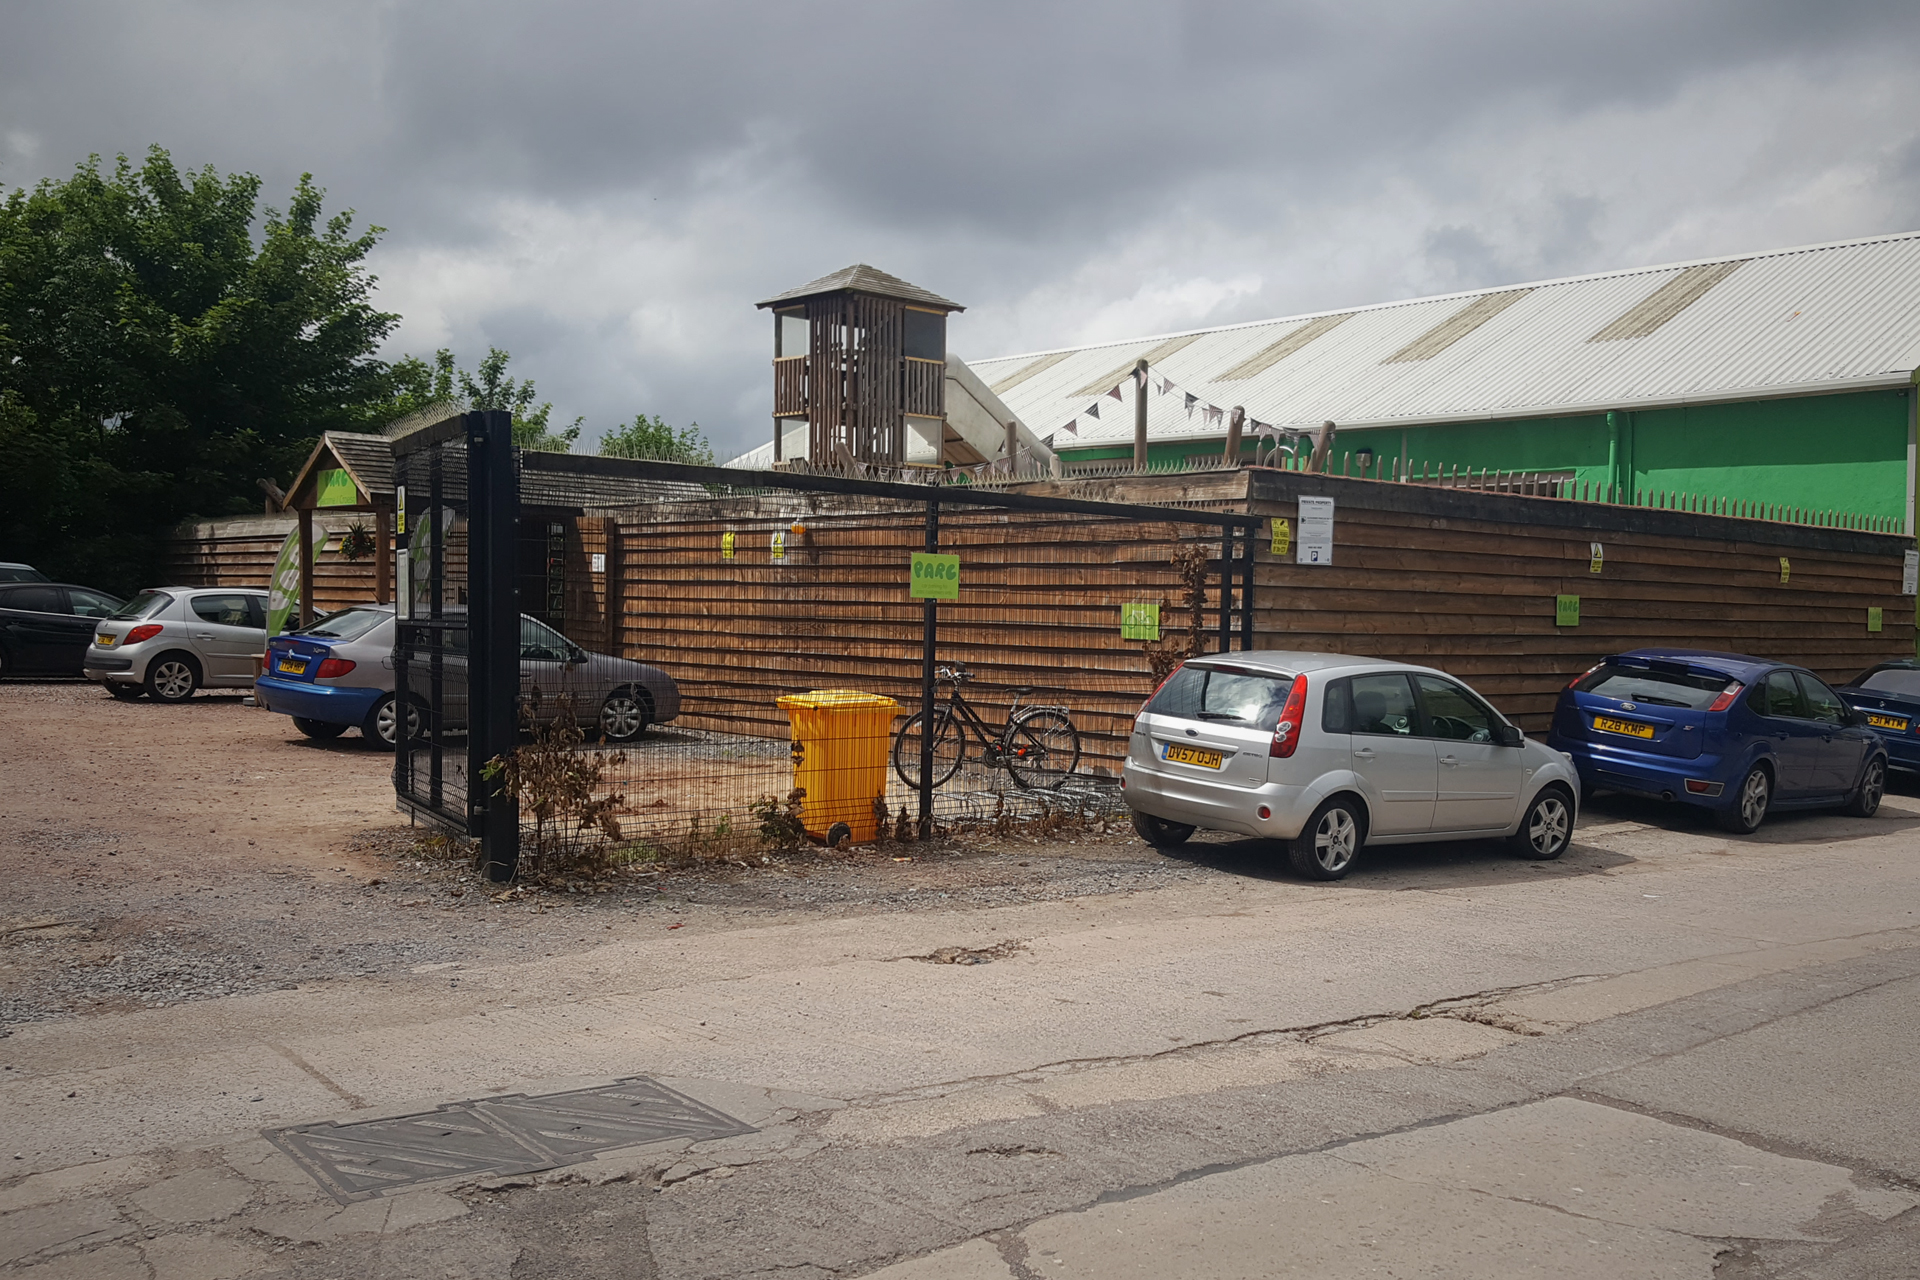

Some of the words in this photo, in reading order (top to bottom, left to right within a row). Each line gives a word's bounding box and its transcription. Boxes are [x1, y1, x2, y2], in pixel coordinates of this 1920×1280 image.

[1600, 718, 1622, 731] R28
[1623, 721, 1646, 735] KMP
[1168, 746, 1196, 761] DV57
[1197, 749, 1220, 766] OJH
